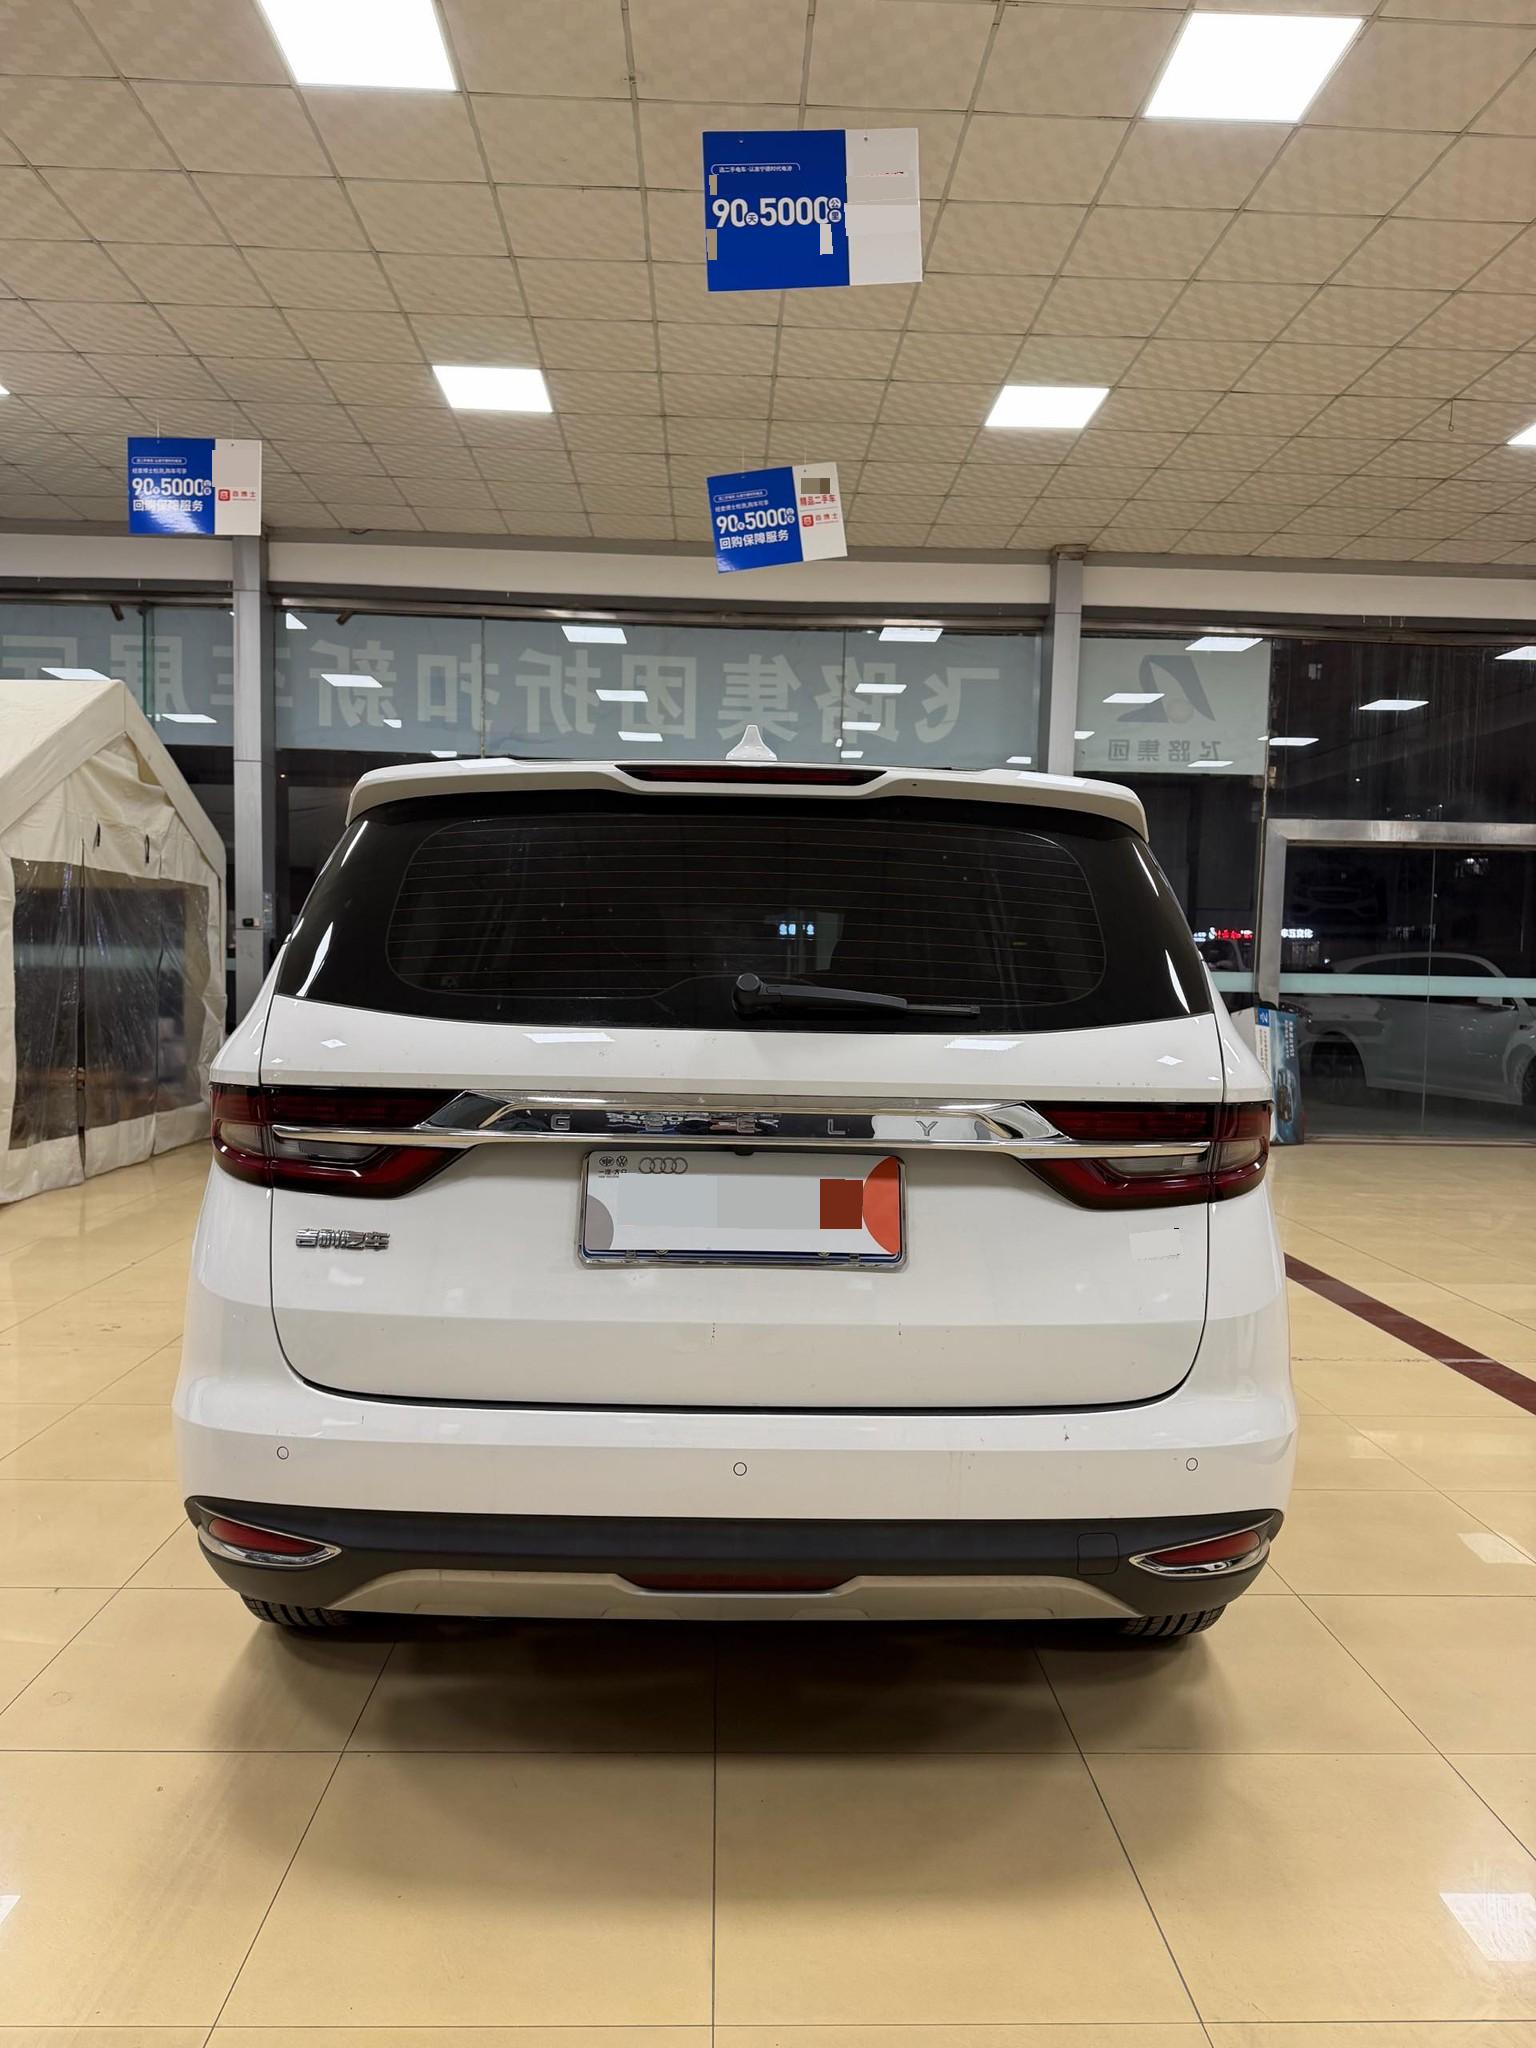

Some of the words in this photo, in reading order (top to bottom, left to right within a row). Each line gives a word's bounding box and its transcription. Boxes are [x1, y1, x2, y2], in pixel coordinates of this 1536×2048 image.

[800, 494, 837, 506] 精品二手车
[719, 529, 789, 550] 回购保障服务
[295, 1228, 390, 1251] 吉利汽车
